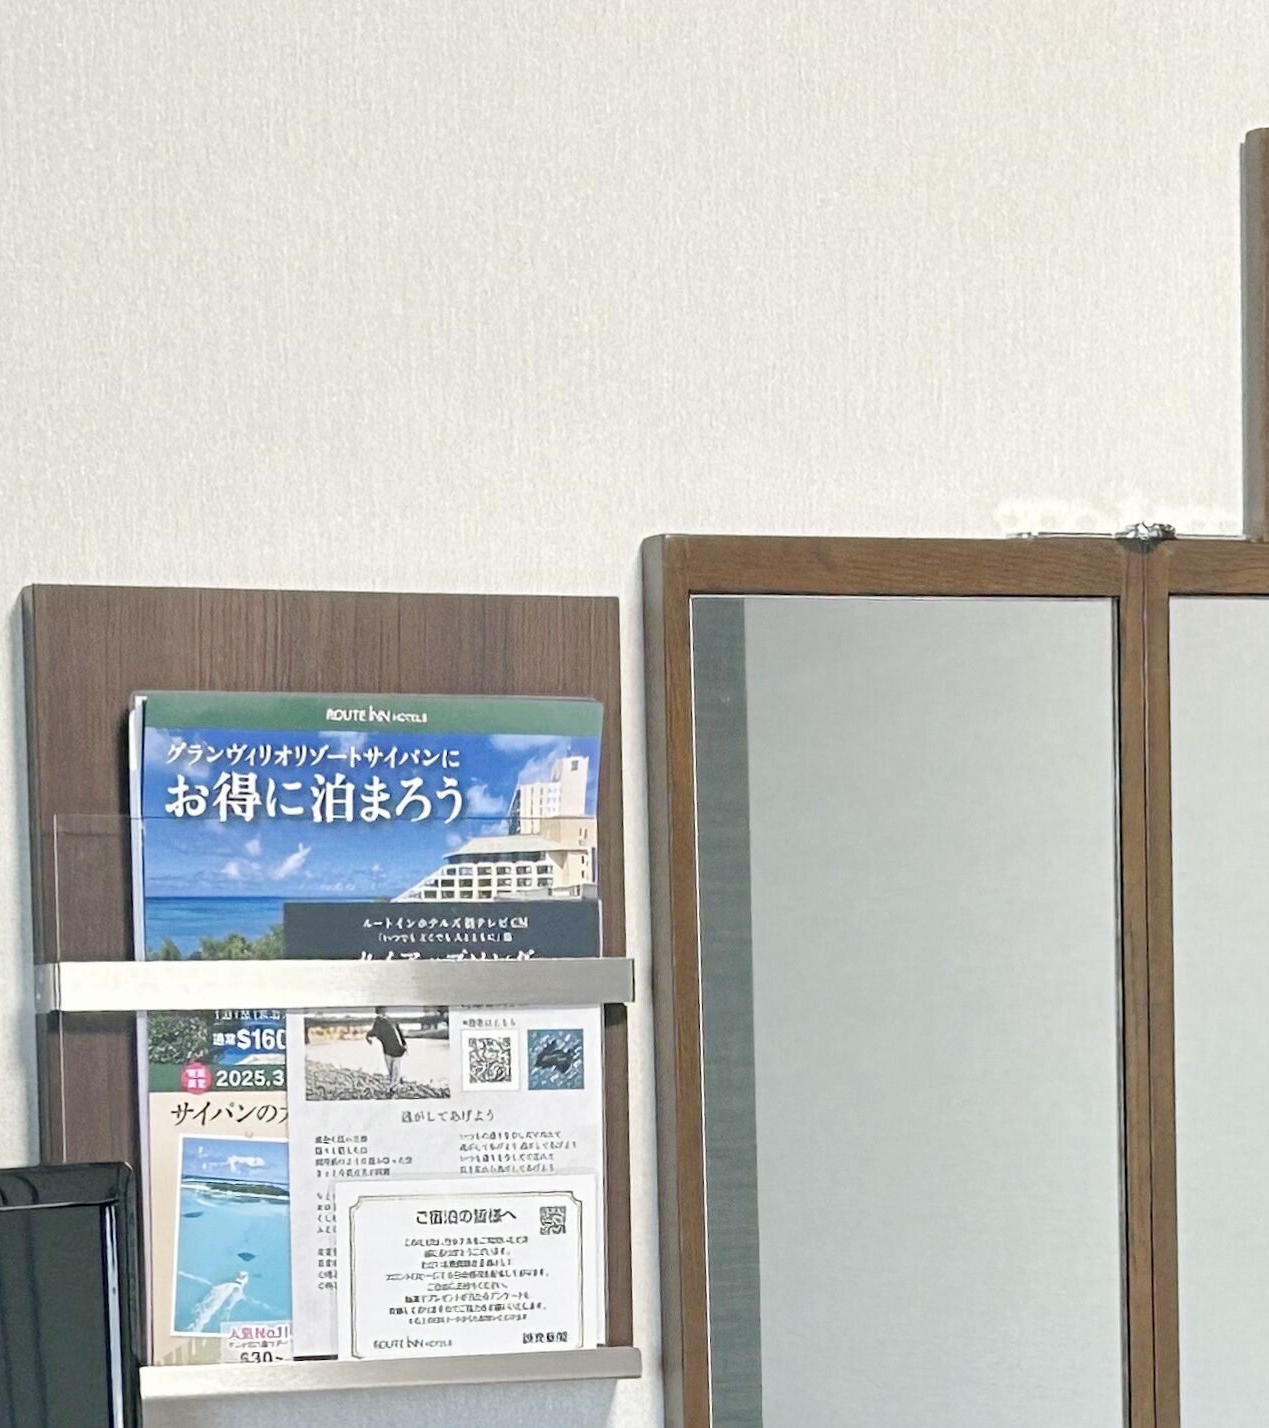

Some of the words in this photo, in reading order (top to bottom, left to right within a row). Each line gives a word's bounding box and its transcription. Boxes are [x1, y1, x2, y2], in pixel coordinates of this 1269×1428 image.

[166, 742, 461, 769] グランヴィリオリゾートサイパンに
[164, 771, 465, 824] お得に泊まろう
[215, 1069, 286, 1087] 2025.3
